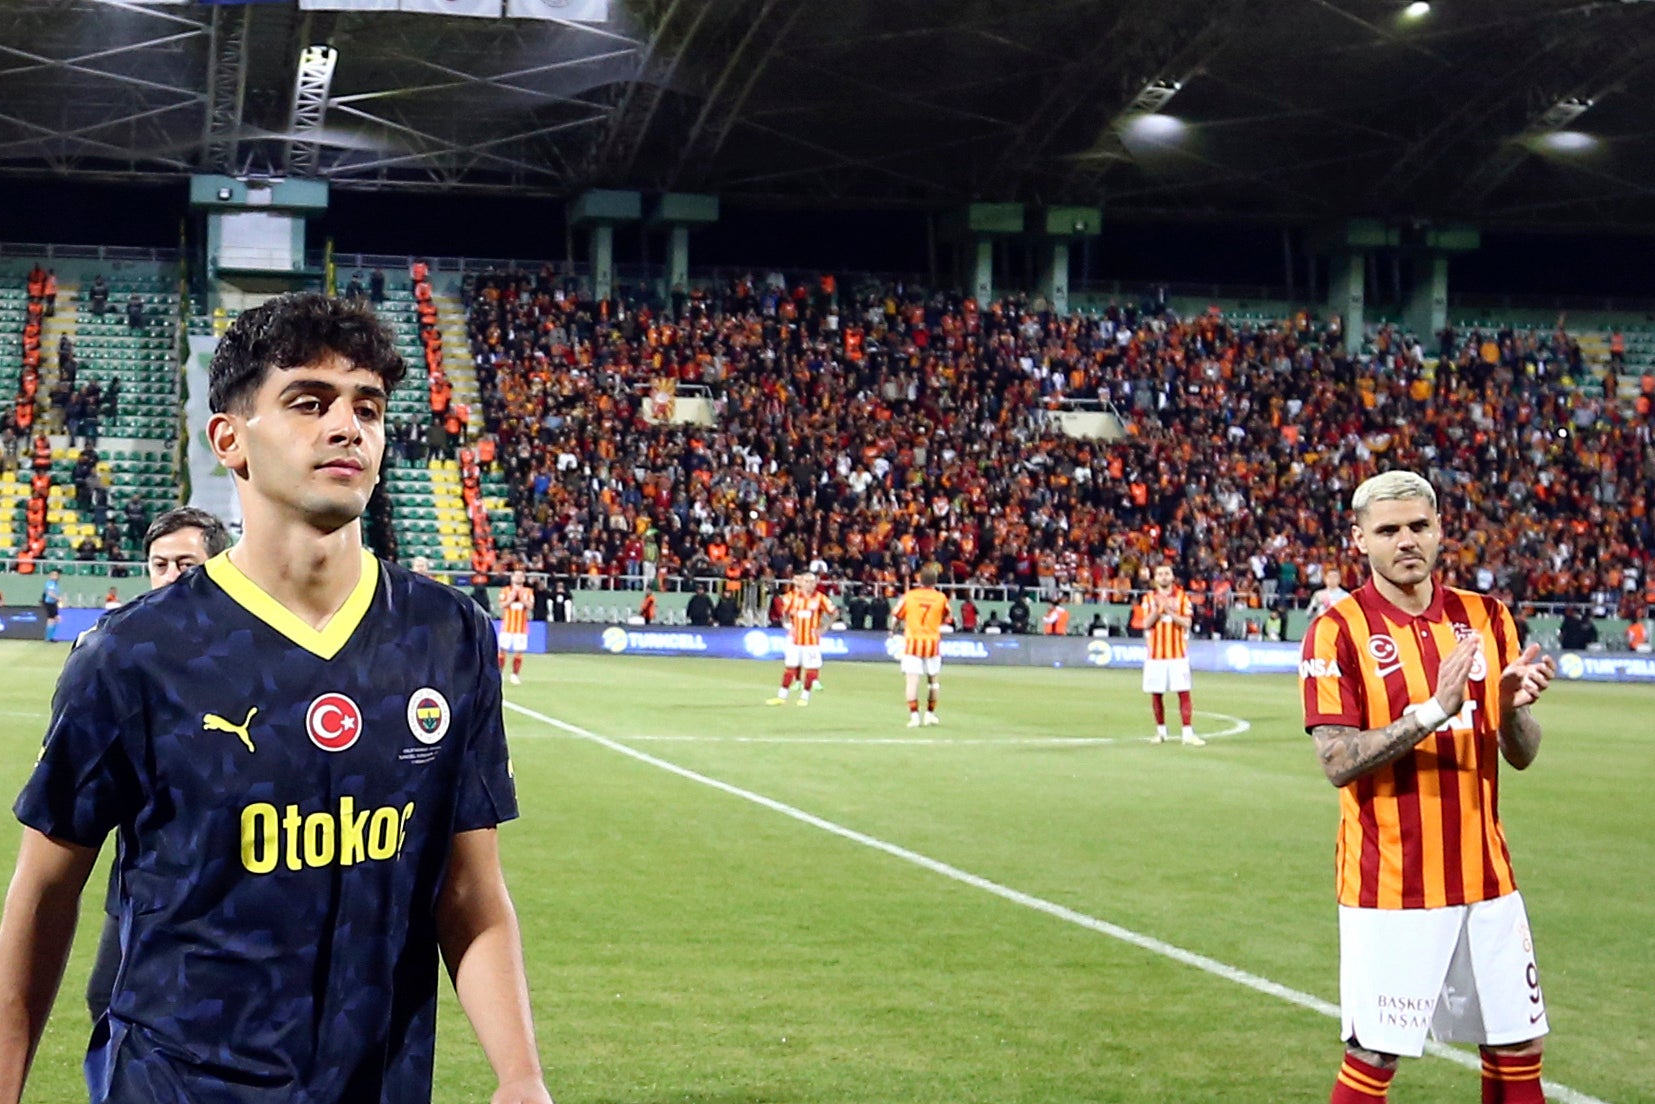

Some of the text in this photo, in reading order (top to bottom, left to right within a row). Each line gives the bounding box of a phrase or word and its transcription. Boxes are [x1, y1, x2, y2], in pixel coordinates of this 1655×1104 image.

[628, 632, 707, 650] TURKCELL
[1378, 994, 1435, 1012] BAŞKEN
[1379, 1009, 1428, 1029] İNŞAA
